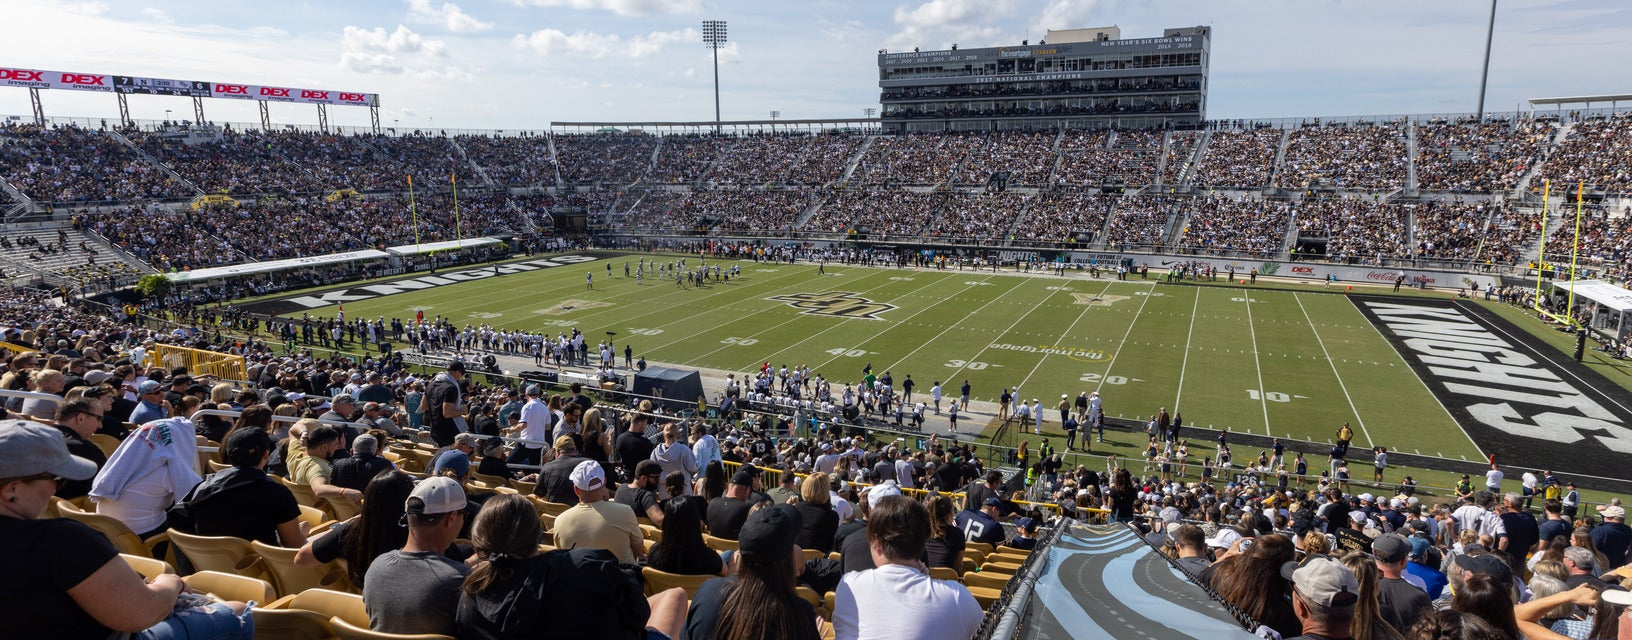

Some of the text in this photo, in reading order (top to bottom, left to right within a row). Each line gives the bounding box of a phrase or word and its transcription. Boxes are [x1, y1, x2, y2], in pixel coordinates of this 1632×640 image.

[0, 69, 43, 82] DEX
[61, 73, 104, 86] DEX
[8, 80, 50, 88] imaging
[73, 83, 111, 91] imaging
[215, 83, 248, 95] DEX
[259, 87, 290, 97] DEX
[301, 90, 329, 99] DEX
[339, 92, 365, 102] DEX
[286, 254, 599, 308] KNIGHTS
[1413, 276, 1436, 284] Wawa
[720, 336, 759, 346] 50
[825, 347, 867, 357] 40
[944, 359, 989, 370] 30
[1080, 373, 1128, 385] 20
[1363, 301, 1632, 454] KNIGHTS
[651, 387, 663, 399] N
[1246, 389, 1290, 402] 10
[755, 442, 766, 453] 13
[1236, 474, 1257, 487] 126
[964, 518, 984, 544] 12
